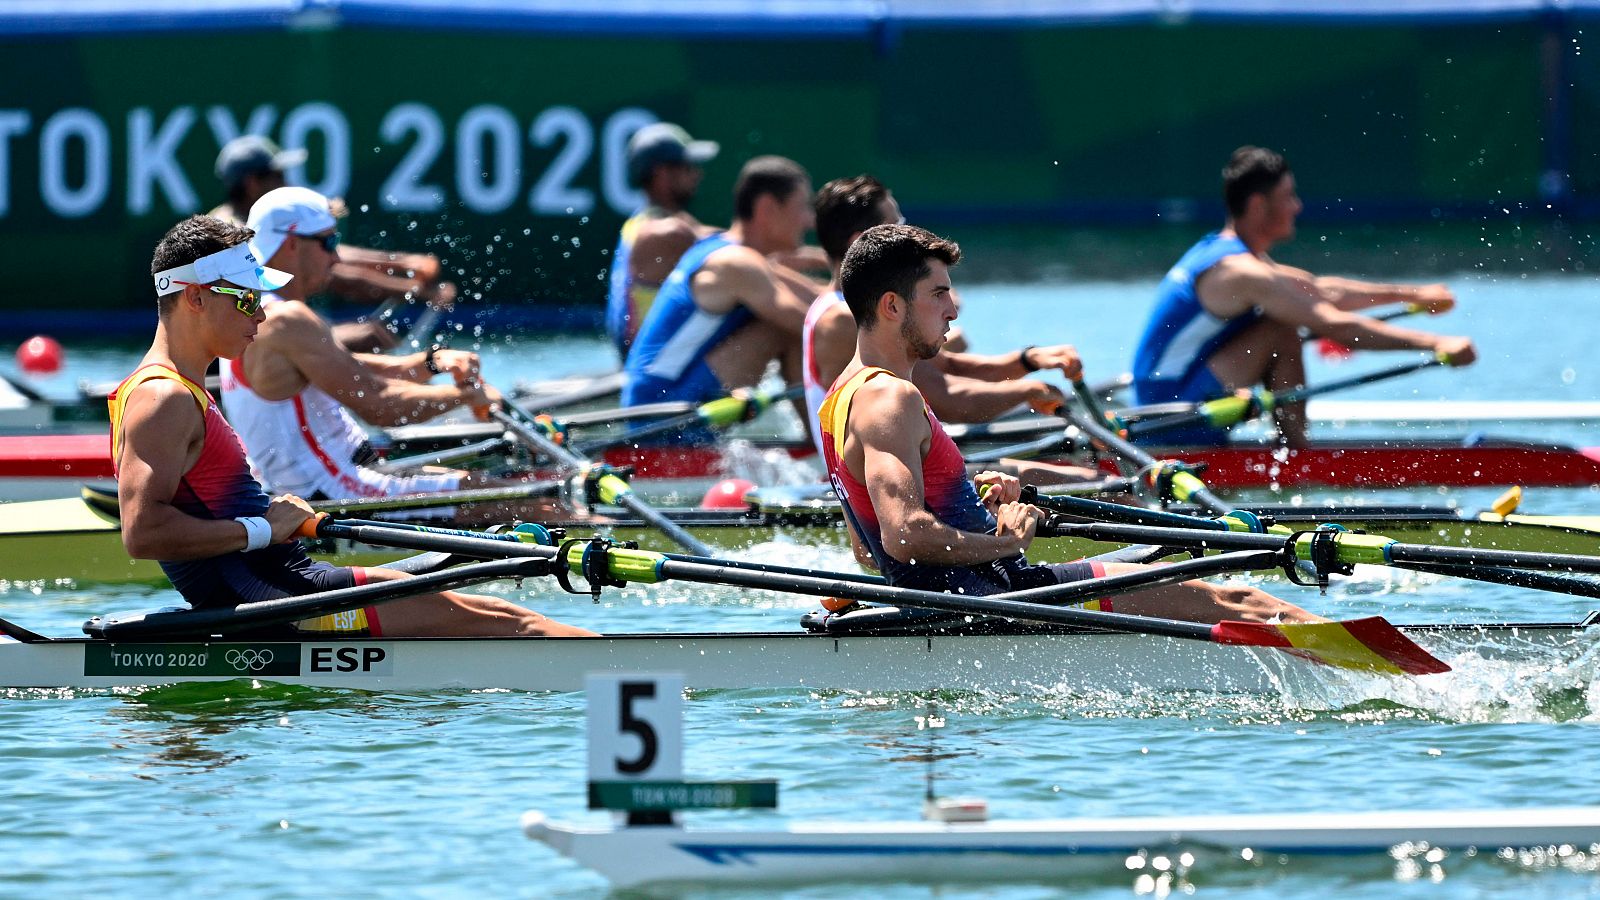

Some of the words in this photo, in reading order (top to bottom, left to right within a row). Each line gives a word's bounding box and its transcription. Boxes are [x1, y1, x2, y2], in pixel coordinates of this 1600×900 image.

[333, 609, 357, 629] ESP
[112, 653, 164, 667] TOKYO
[167, 653, 206, 667] 2020
[310, 647, 386, 673] ESP
[614, 680, 659, 775] 5
